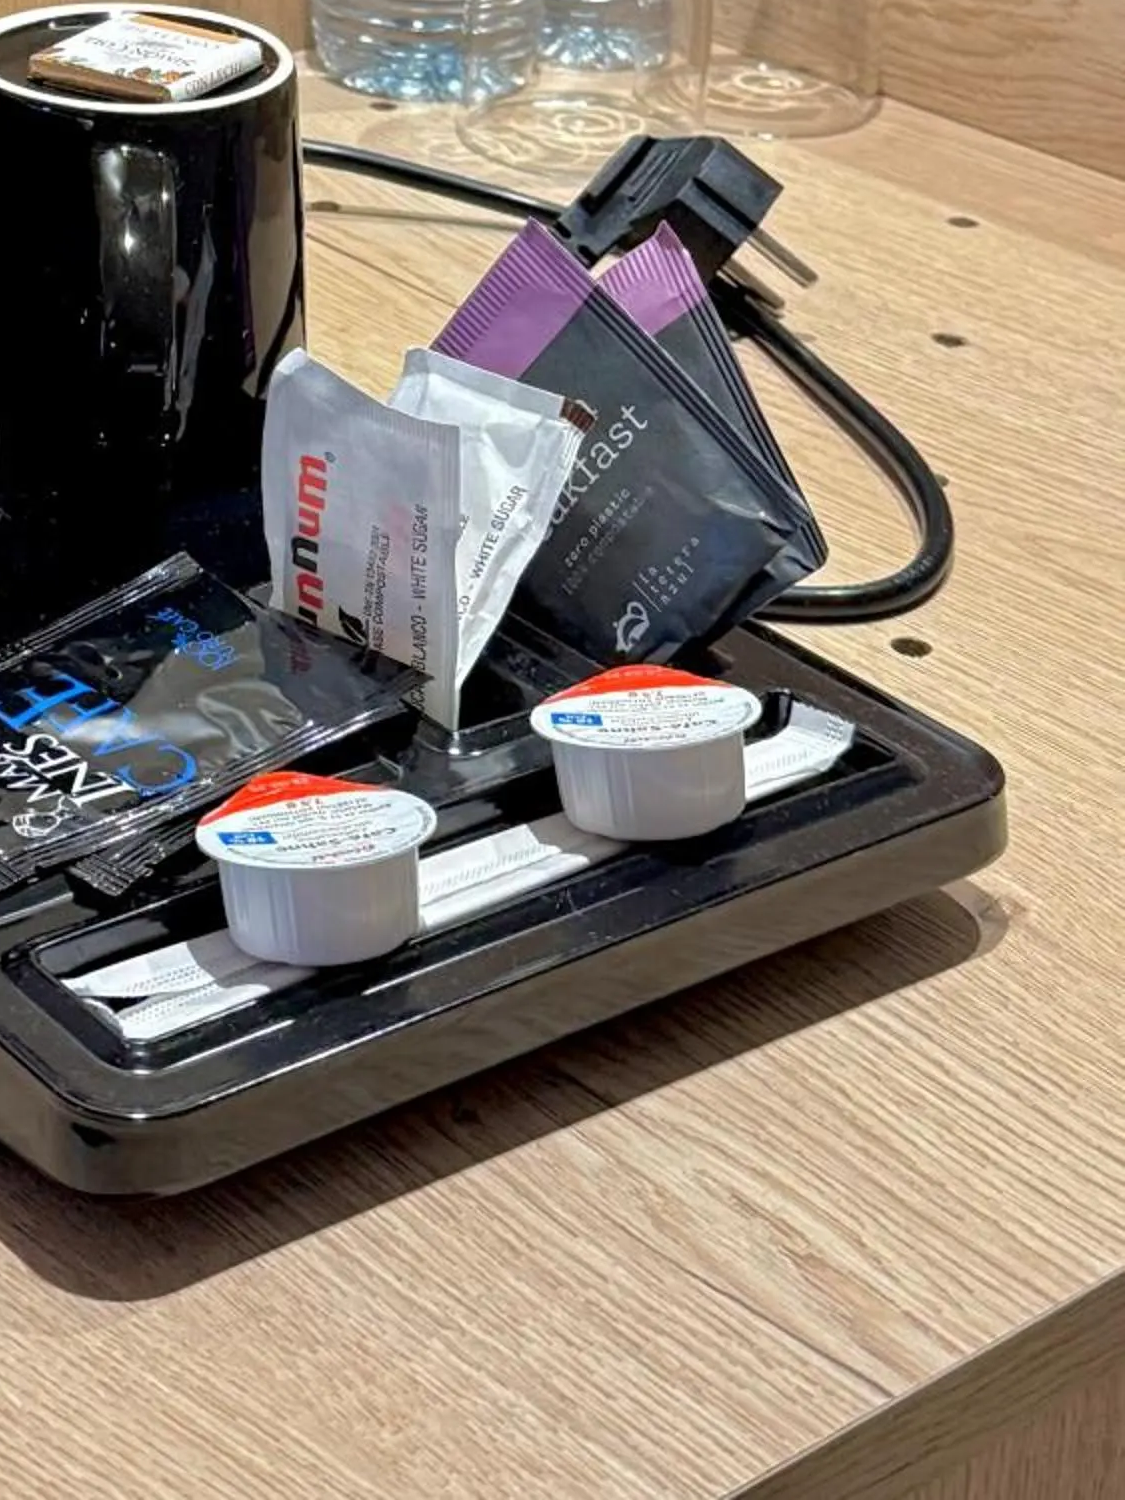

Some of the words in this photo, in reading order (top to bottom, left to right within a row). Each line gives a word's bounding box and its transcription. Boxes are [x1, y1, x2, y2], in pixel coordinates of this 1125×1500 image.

[543, 403, 649, 542] akfast
[411, 504, 429, 552] SUGAR
[470, 532, 500, 579] WHITE
[491, 485, 530, 532] SUGAR
[563, 536, 589, 568] zero
[589, 487, 632, 535] plastic
[410, 557, 427, 600] WHITE
